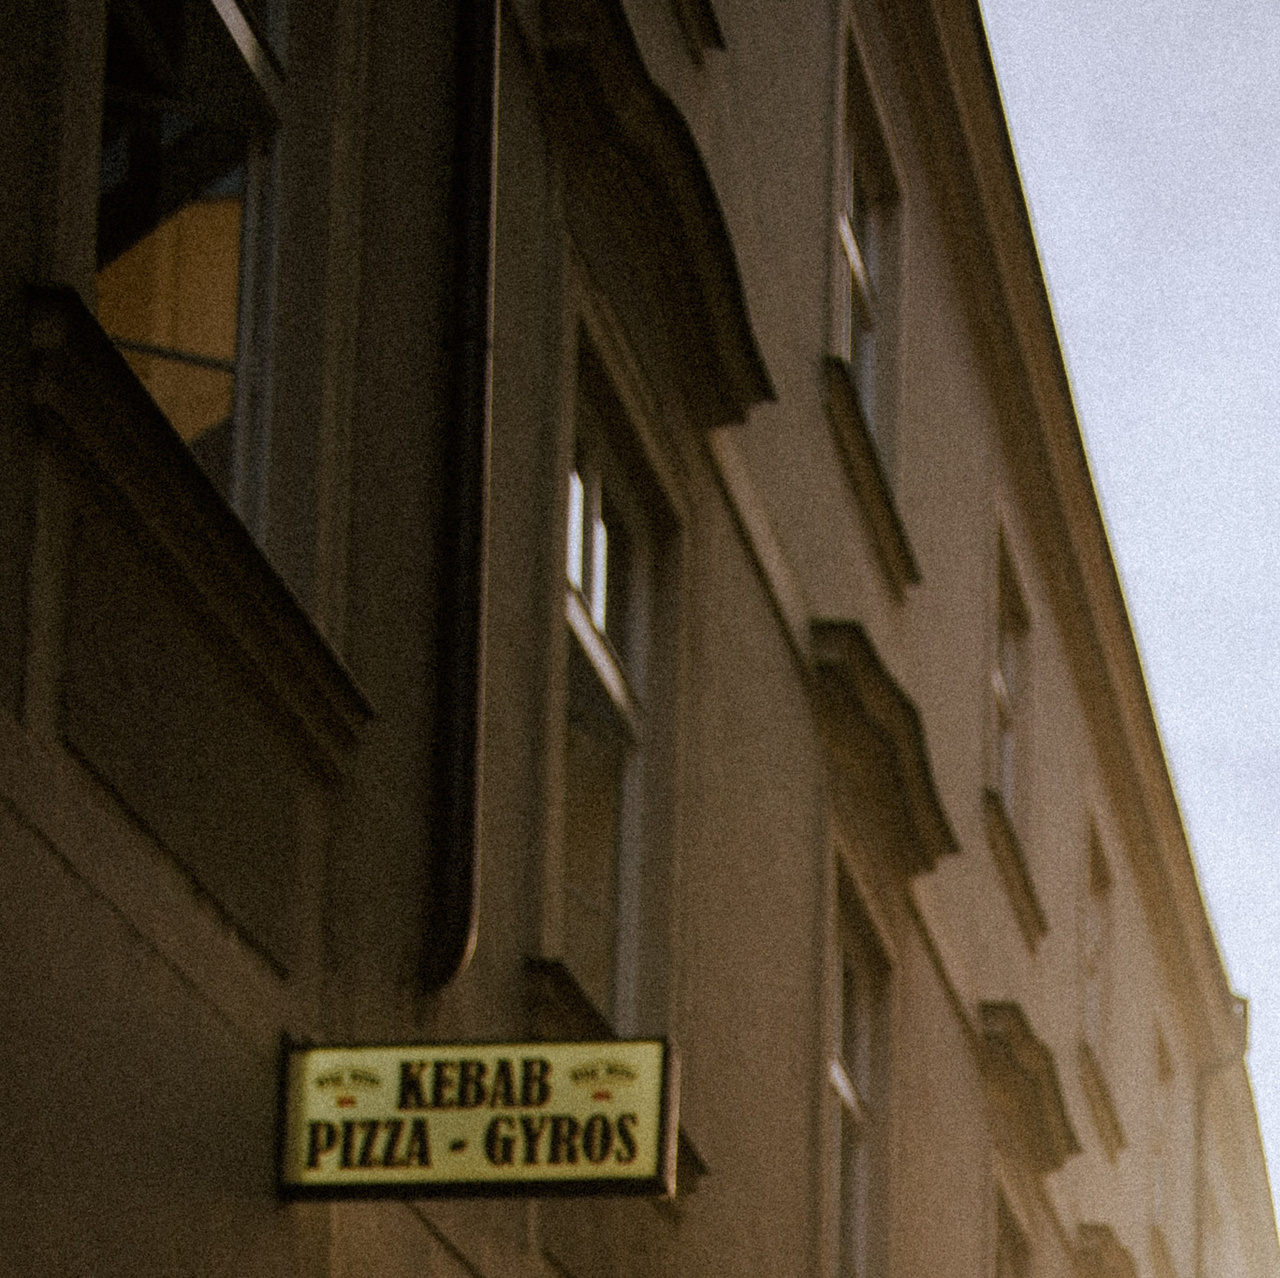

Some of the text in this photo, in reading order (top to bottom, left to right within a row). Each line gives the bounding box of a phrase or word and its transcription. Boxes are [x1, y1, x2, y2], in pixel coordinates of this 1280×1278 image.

[397, 1057, 554, 1112] KEBAB
[305, 1117, 433, 1171] PIZZA
[482, 1111, 640, 1168] GYROS
